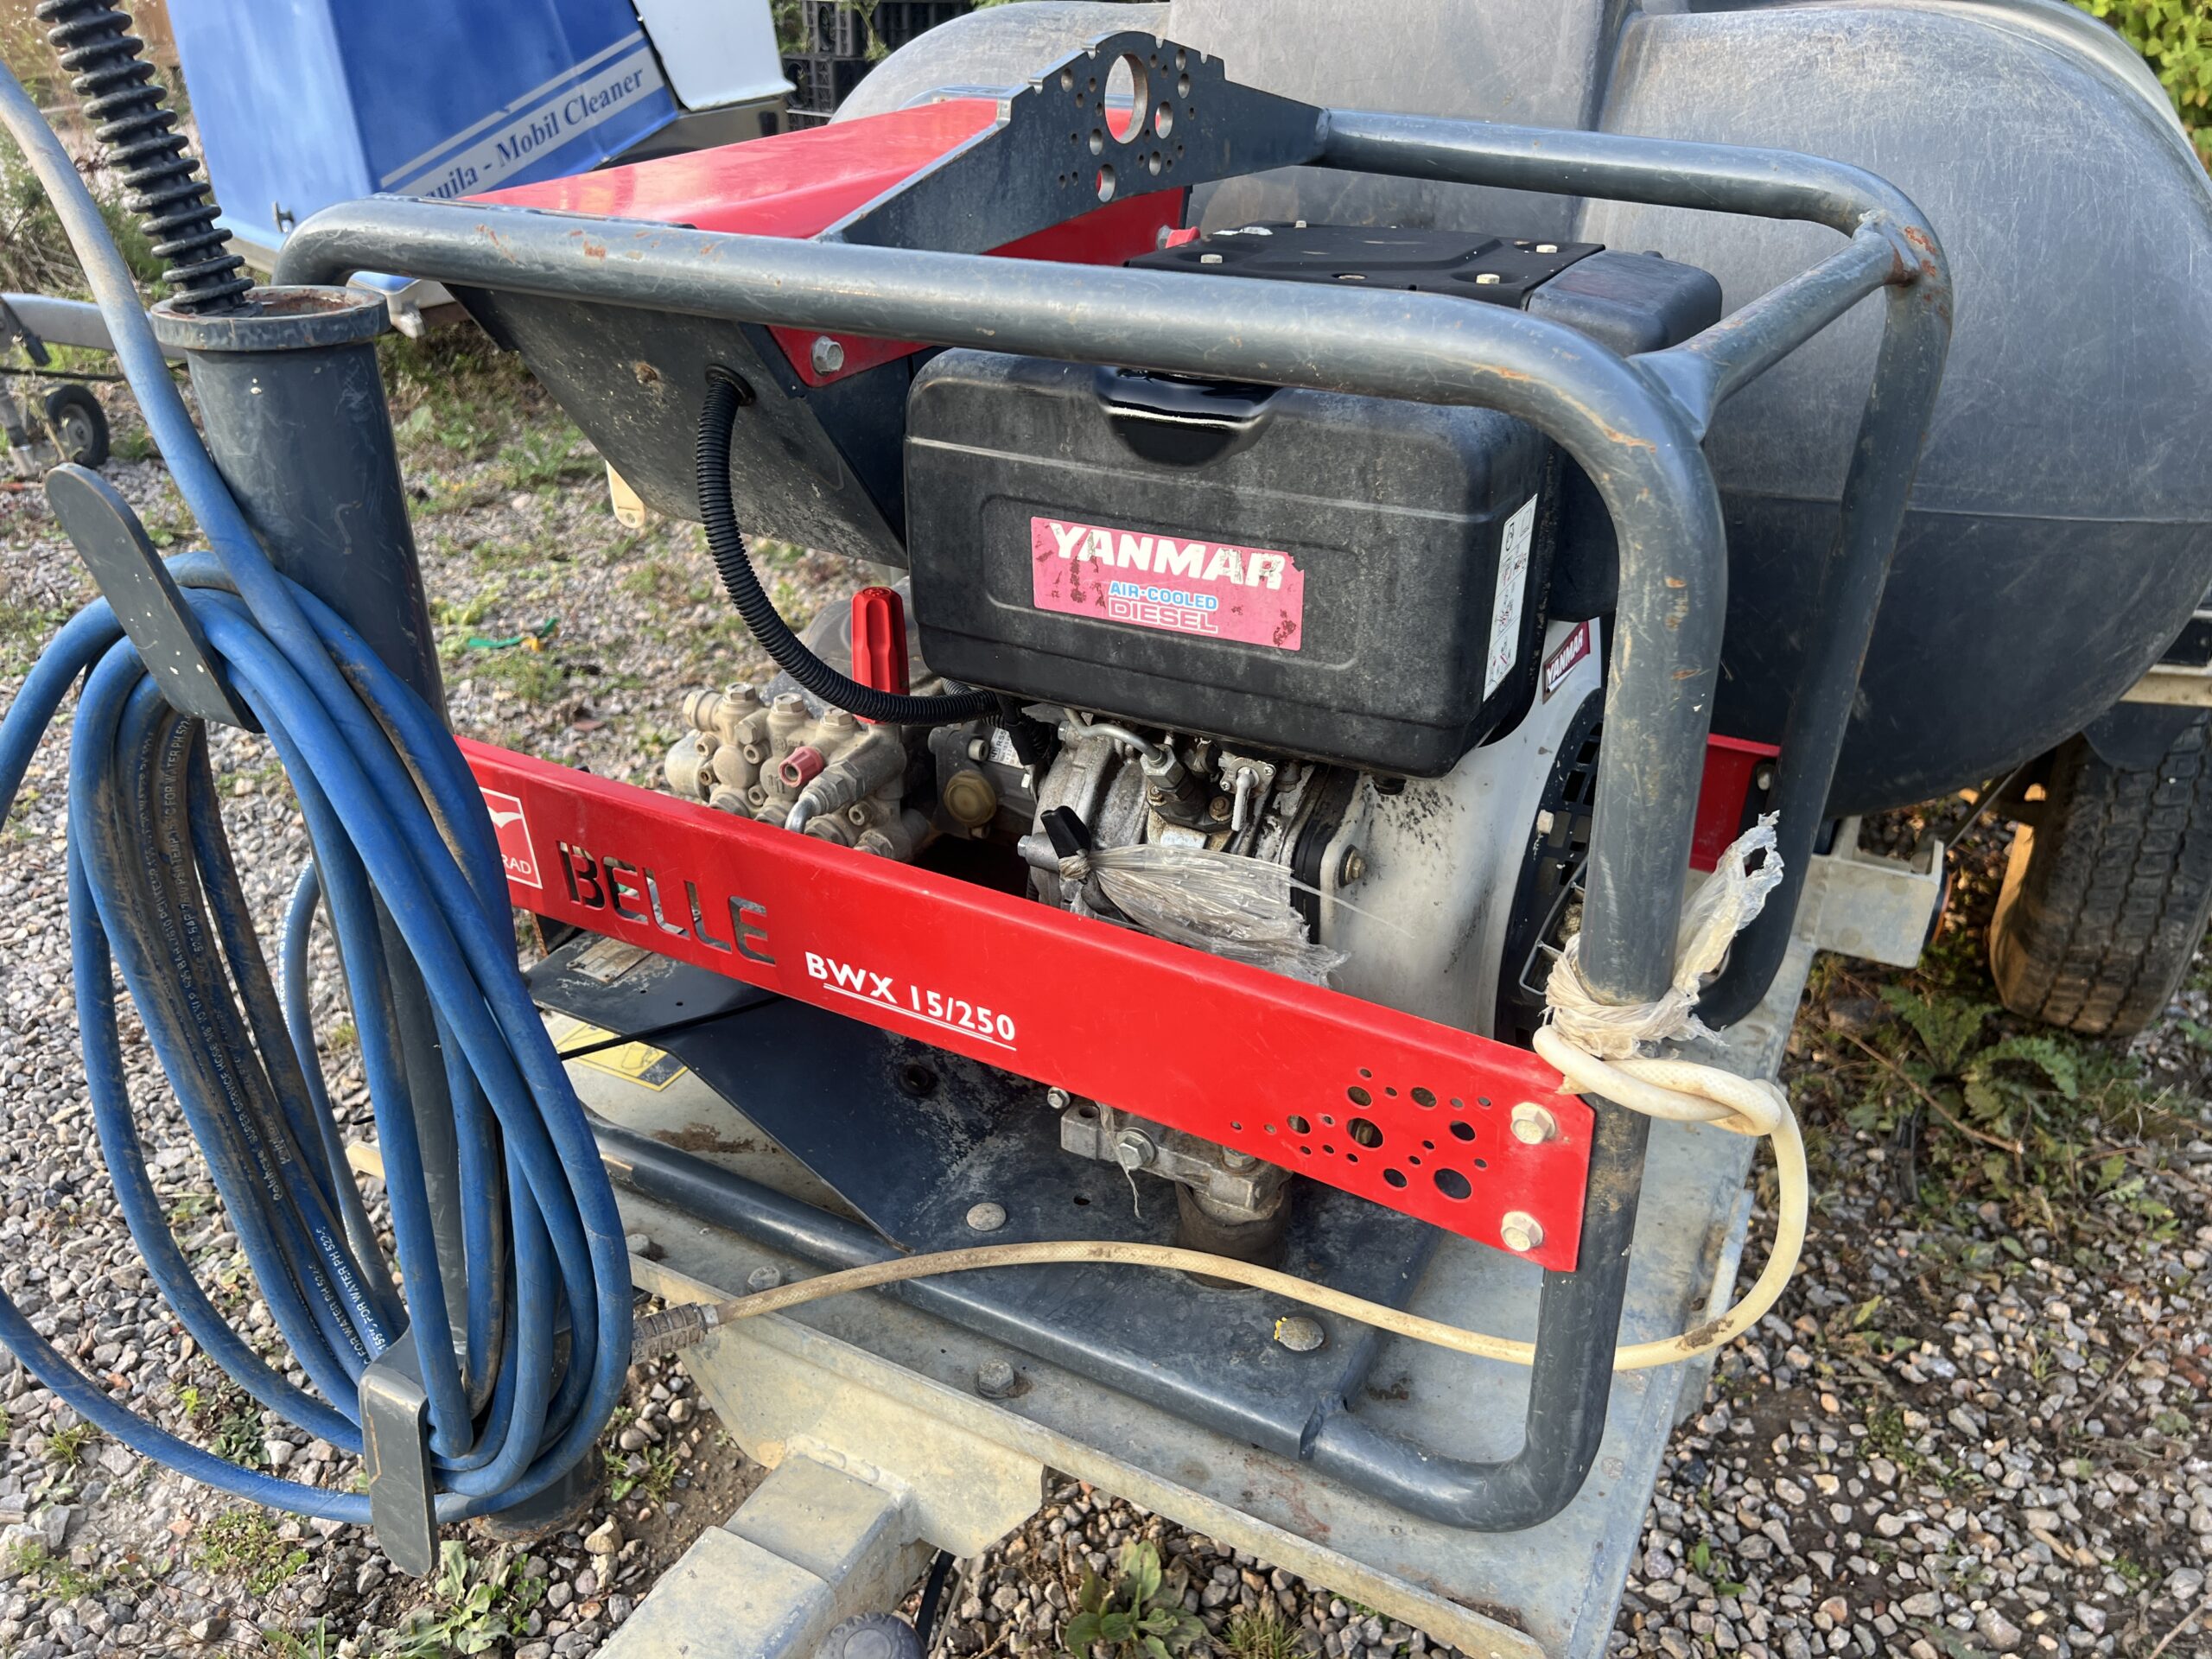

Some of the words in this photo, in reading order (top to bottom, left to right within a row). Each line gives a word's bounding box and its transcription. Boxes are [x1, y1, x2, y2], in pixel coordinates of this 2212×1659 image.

[496, 115, 560, 168] Mobil
[564, 68, 644, 125] Cleaner
[1049, 522, 1286, 590] YANMAR
[1109, 599, 1218, 633] DIESEL
[1546, 628, 1584, 685] YANMAR
[164, 785, 176, 805] FOR
[556, 840, 777, 966] BELLE
[804, 951, 898, 1004] BWX
[910, 984, 1016, 1041] 15/250
[209, 1043, 226, 1071] HOSE
[220, 1071, 244, 1113] SERVICE
[238, 1112, 259, 1145] SUPER
[329, 1251, 343, 1267] PH
[321, 1286, 334, 1302] PH
[337, 1266, 362, 1303] WATER
[329, 1301, 353, 1338] WATER
[357, 1302, 374, 1324] FOR
[350, 1336, 366, 1357] FOR
